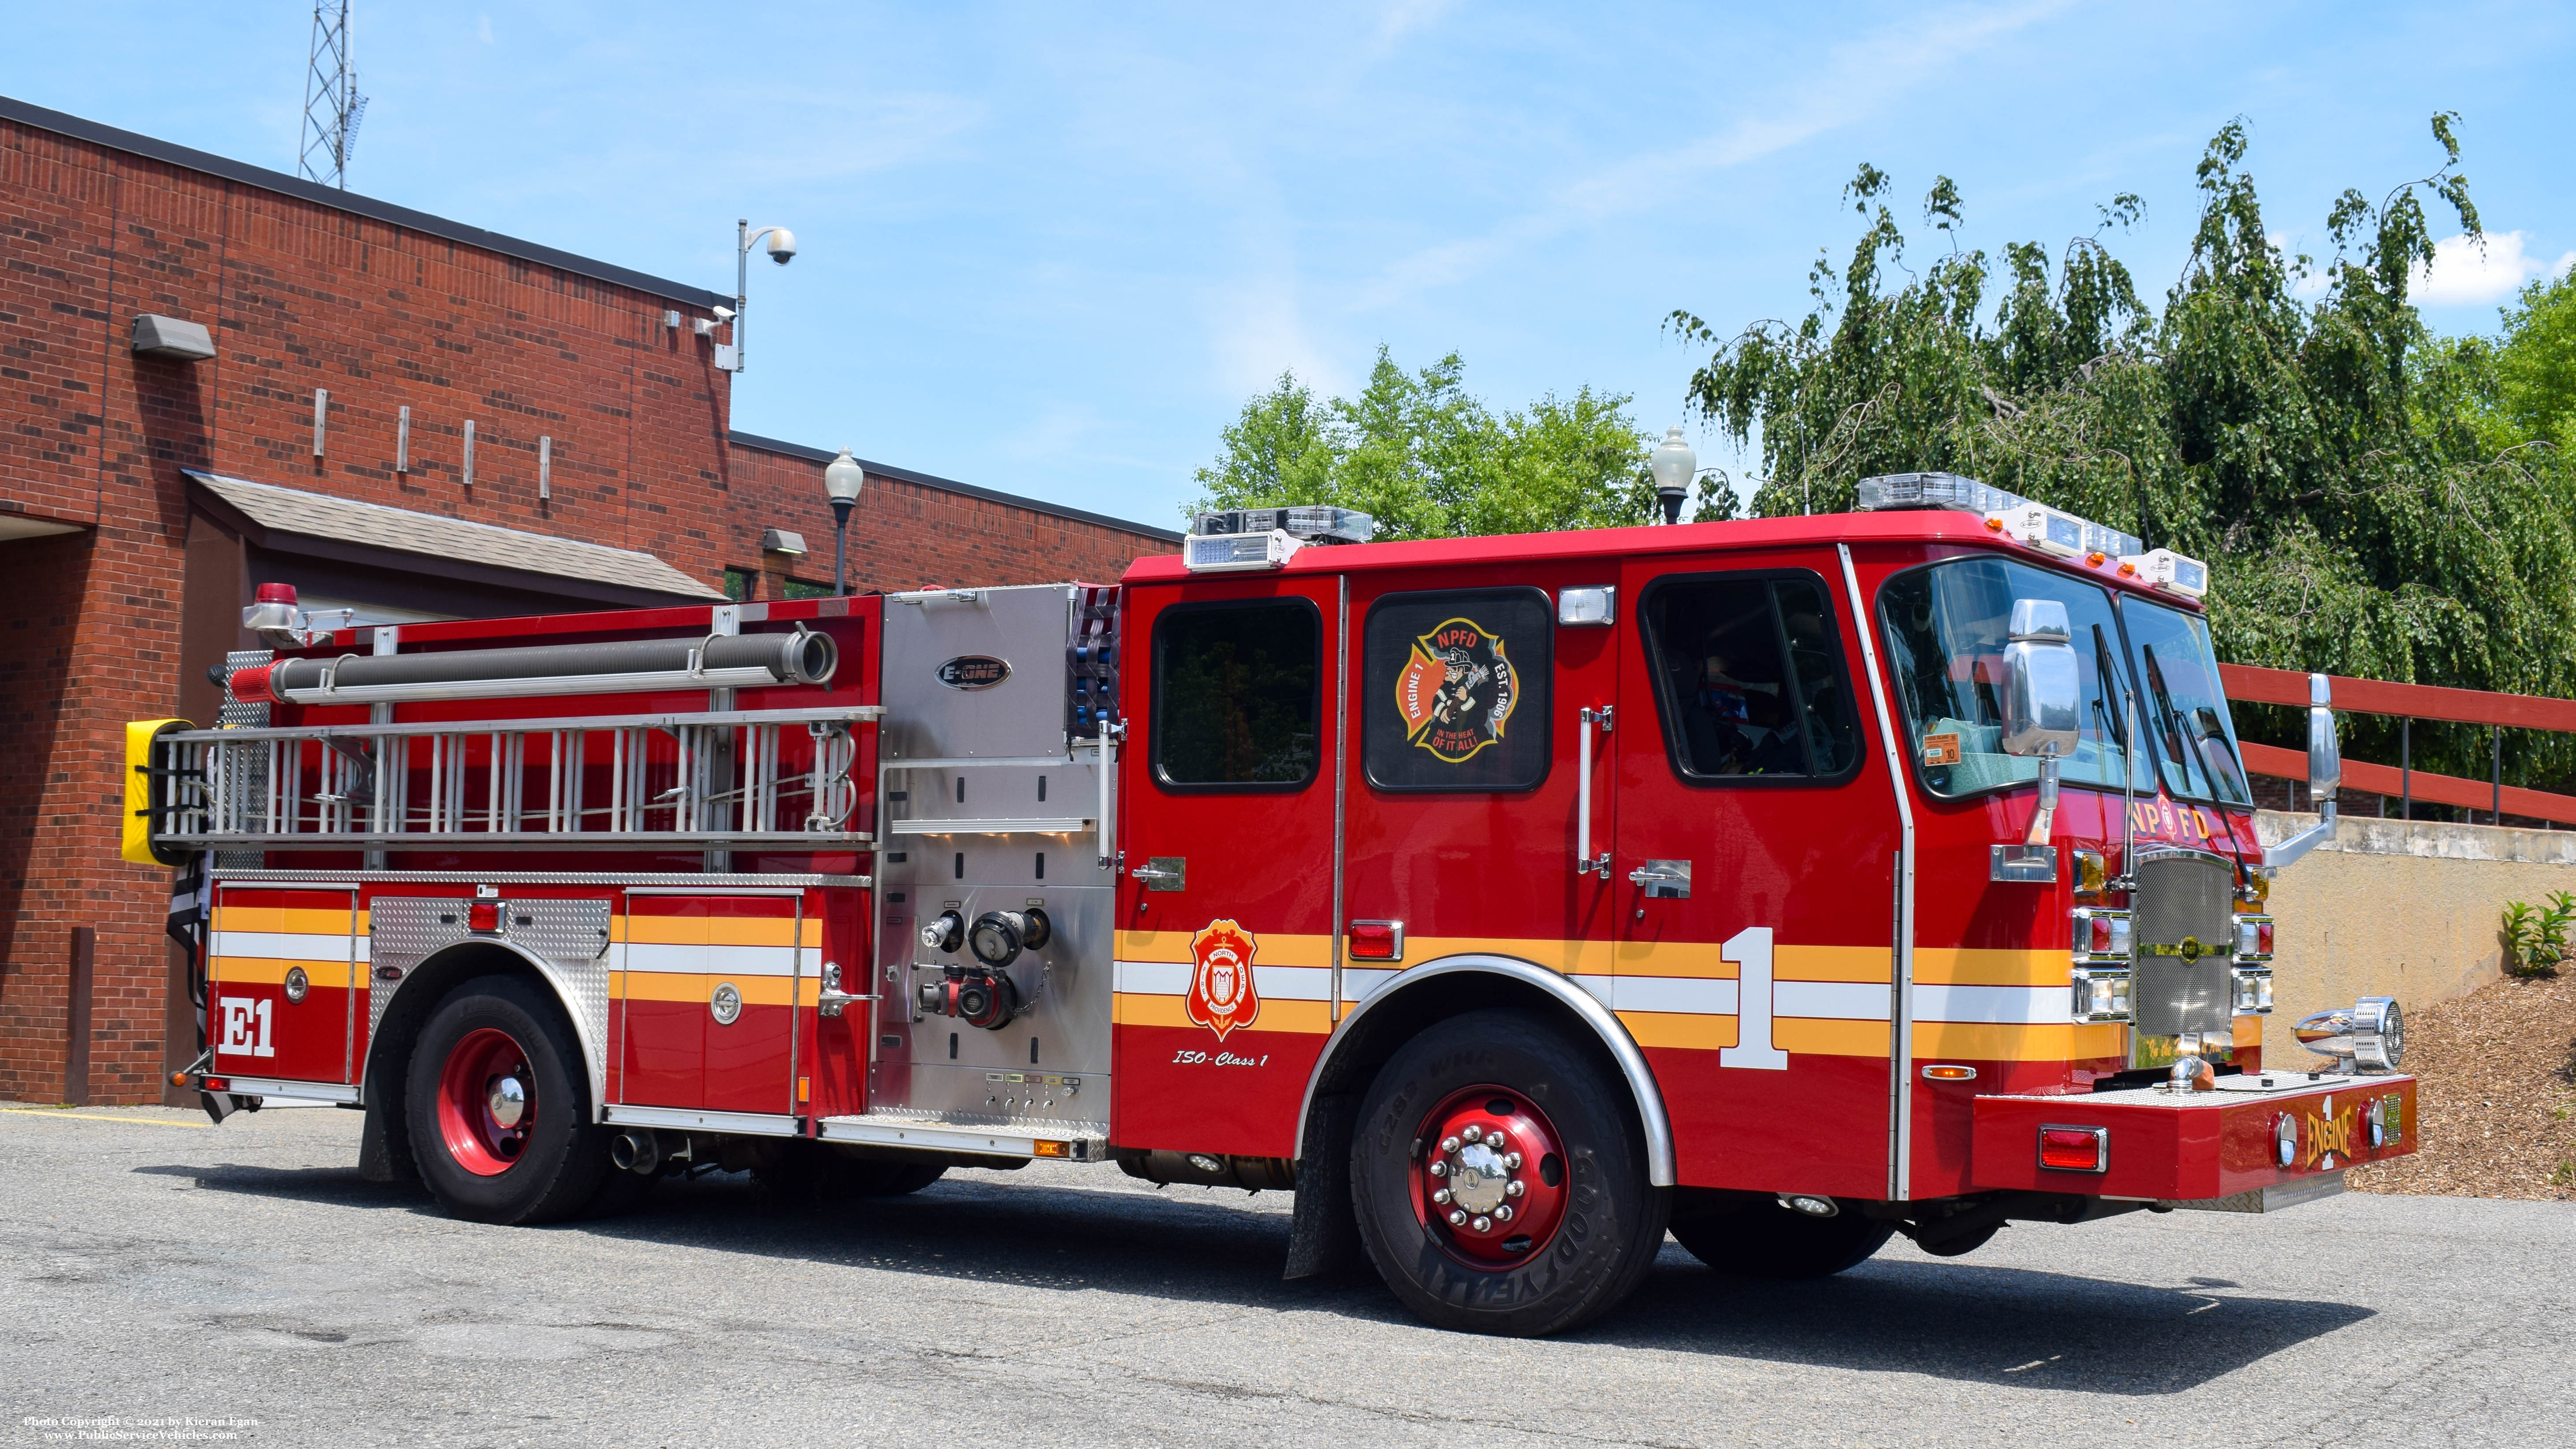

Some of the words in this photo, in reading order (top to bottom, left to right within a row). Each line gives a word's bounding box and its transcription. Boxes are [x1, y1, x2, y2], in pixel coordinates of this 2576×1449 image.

[1437, 630, 1477, 648] NPFD
[944, 664, 1000, 679] E-ONE
[1494, 663, 1508, 689] EST.
[1408, 672, 1421, 719] ENGINE
[1493, 692, 1508, 718] 1906
[1437, 729, 1444, 737] IN
[1458, 728, 1474, 739] HEAT
[1433, 737, 1445, 749] OF
[1446, 741, 1456, 751] IT
[1458, 736, 1478, 751] ALL!
[1946, 749, 1954, 759] 10
[1720, 927, 1787, 1070] 1
[1210, 1003, 1235, 1013] PROVIDENCE
[218, 997, 275, 1057] E1
[1173, 1050, 1256, 1066] ISO-Class
[1260, 1054, 1269, 1067] 1
[2307, 1105, 2351, 1168] ENGINE
